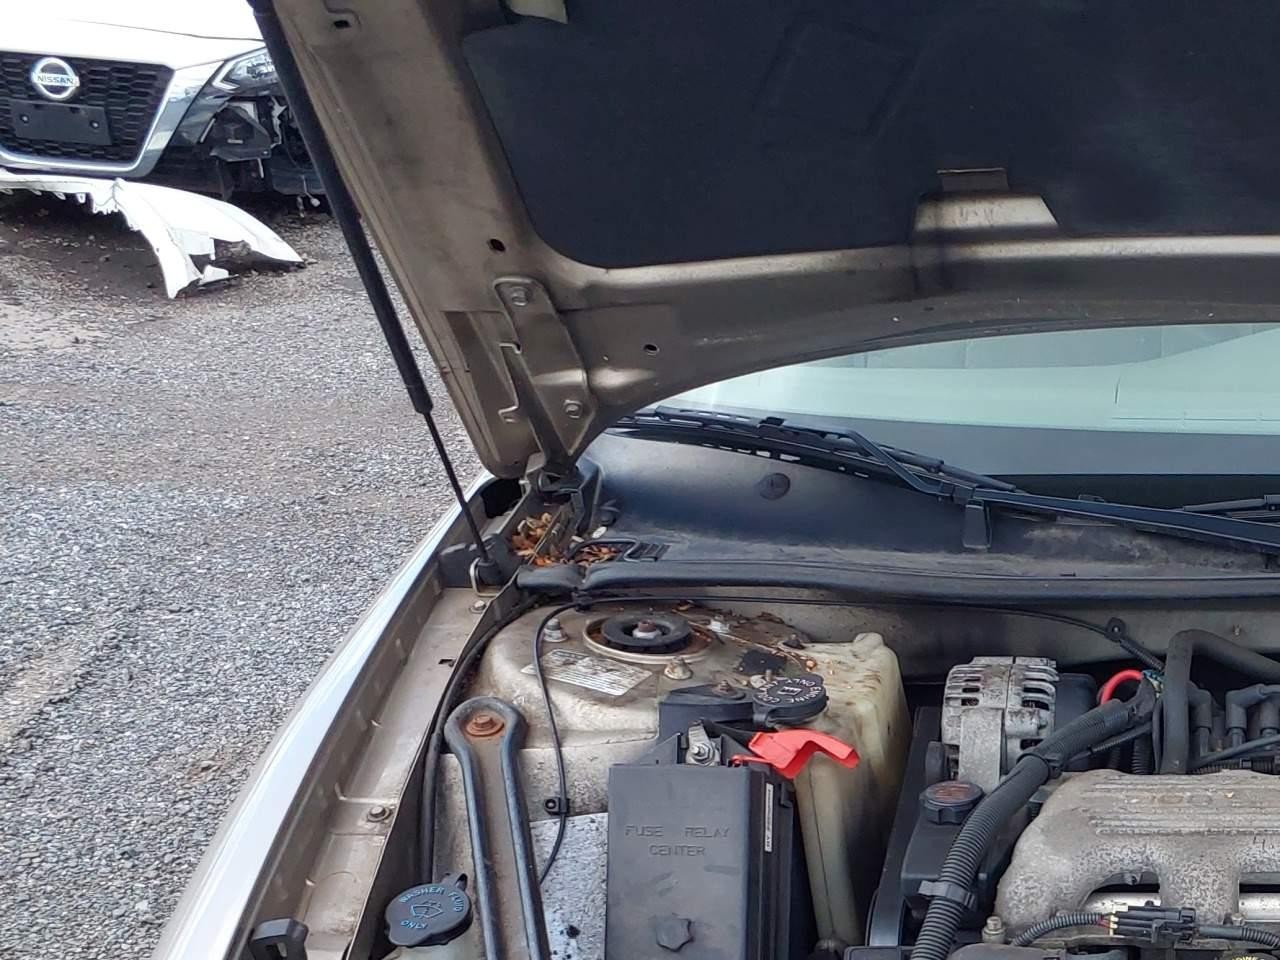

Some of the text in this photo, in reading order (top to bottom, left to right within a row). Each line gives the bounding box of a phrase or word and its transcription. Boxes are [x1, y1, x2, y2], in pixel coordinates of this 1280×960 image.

[37, 75, 74, 84] NISSAN
[625, 825, 730, 838] FUSE RELAY
[650, 844, 705, 857] CENTER
[399, 886, 465, 913] WASHER FLUID
[401, 920, 429, 929] ONLY
